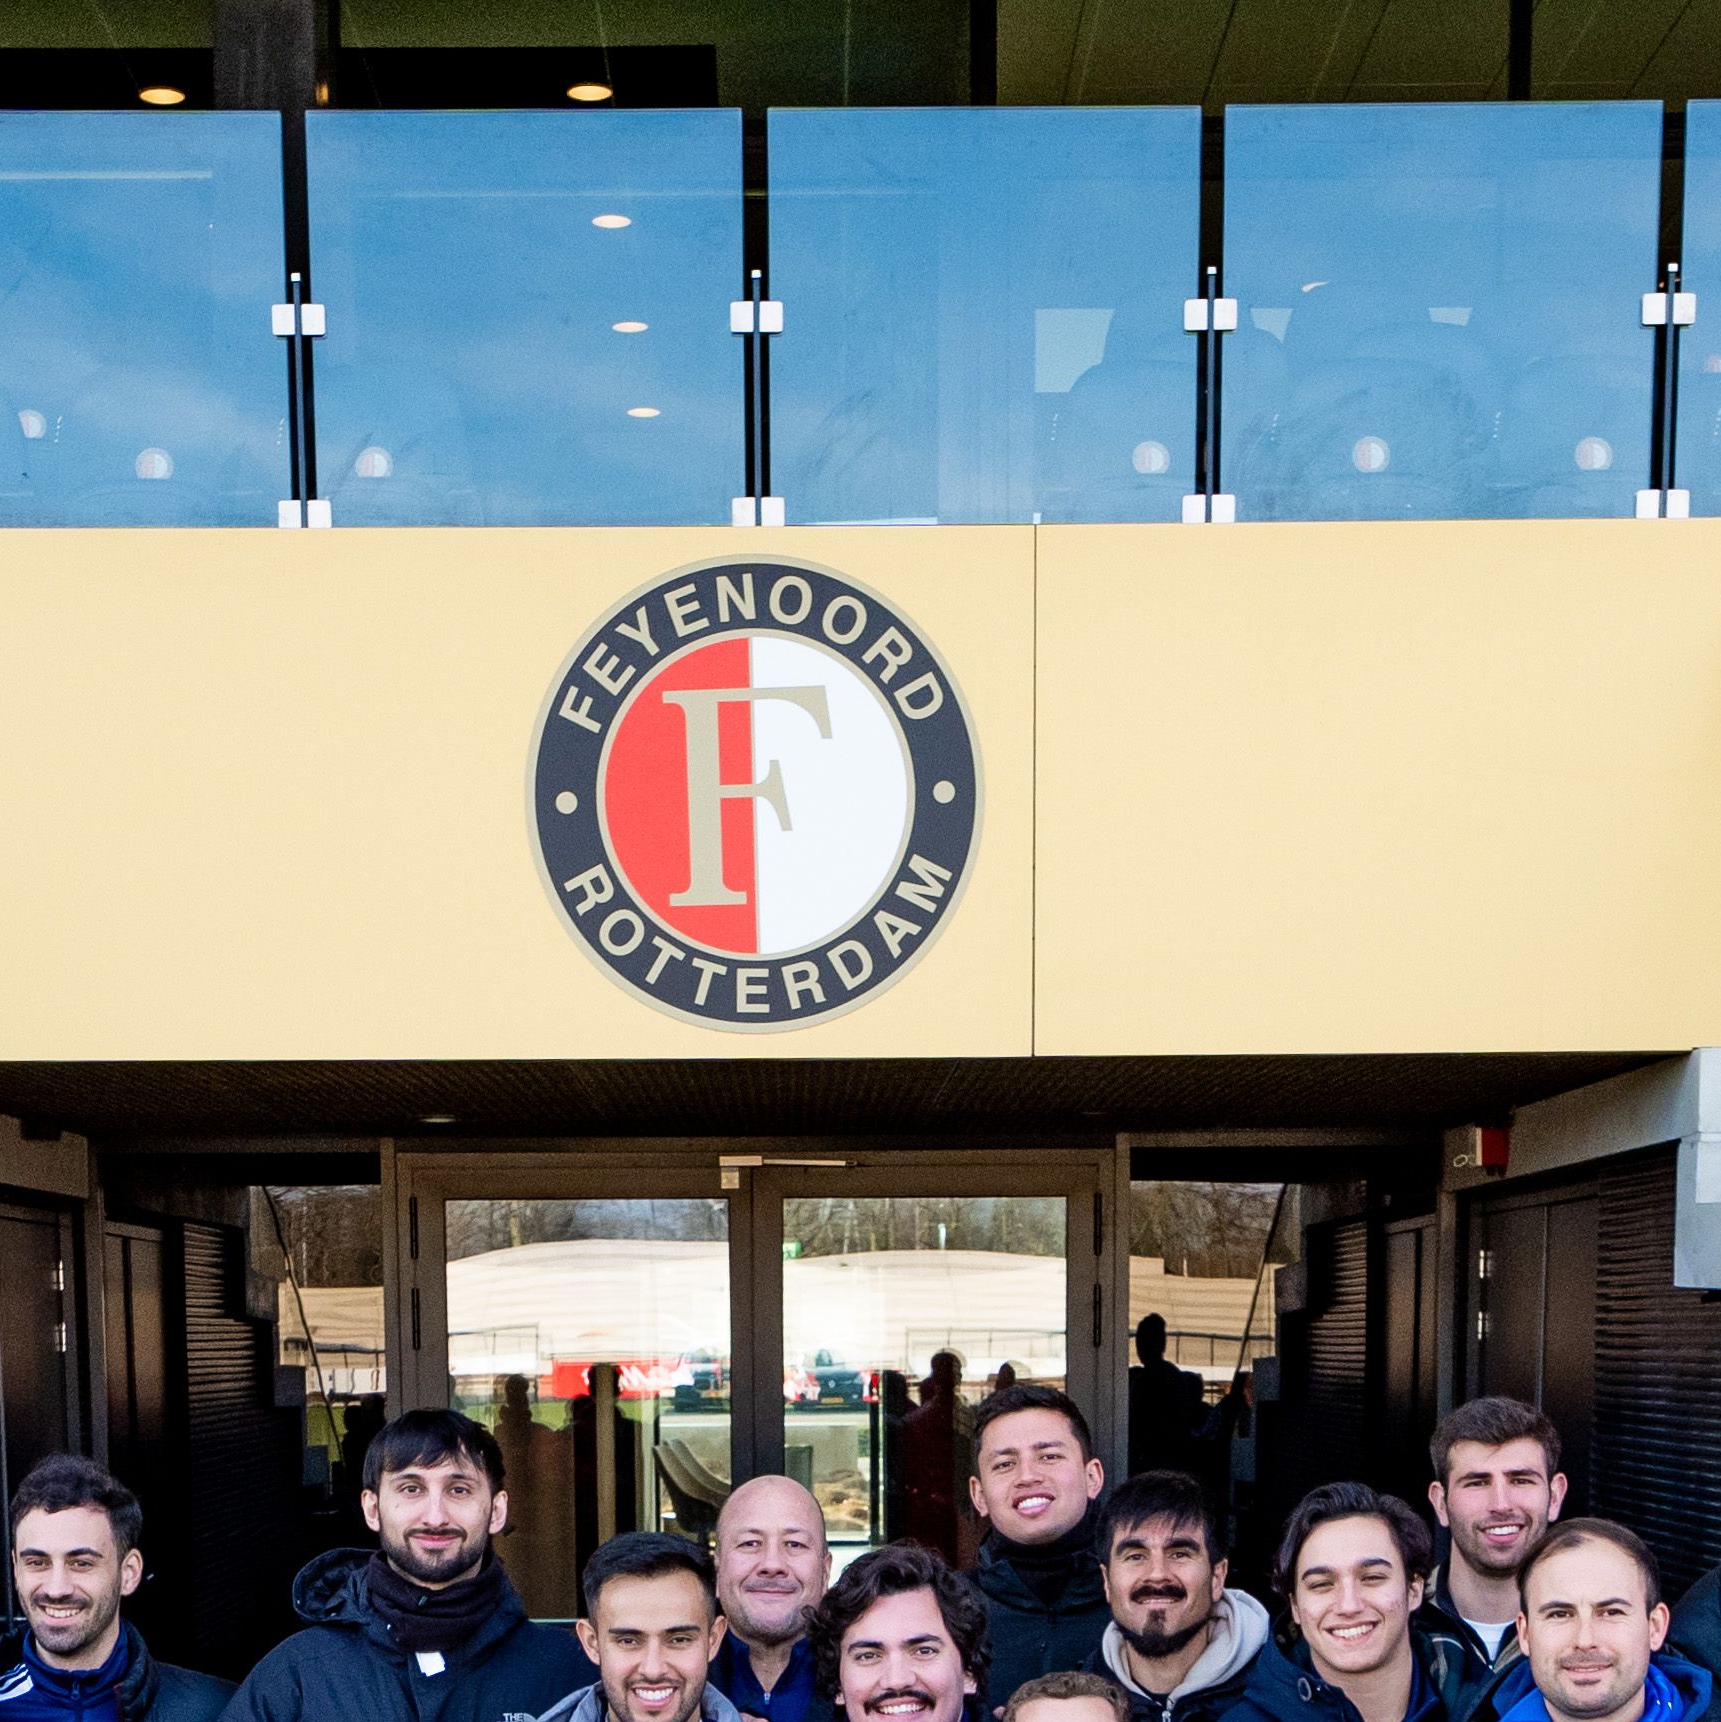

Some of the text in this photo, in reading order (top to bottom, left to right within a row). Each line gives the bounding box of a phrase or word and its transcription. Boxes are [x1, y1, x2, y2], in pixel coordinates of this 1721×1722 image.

[558, 573, 943, 734] FEYENOORD
[662, 685, 833, 907] F
[564, 853, 953, 1014] ROTTERDAM
[502, 1712, 525, 1722] THE
